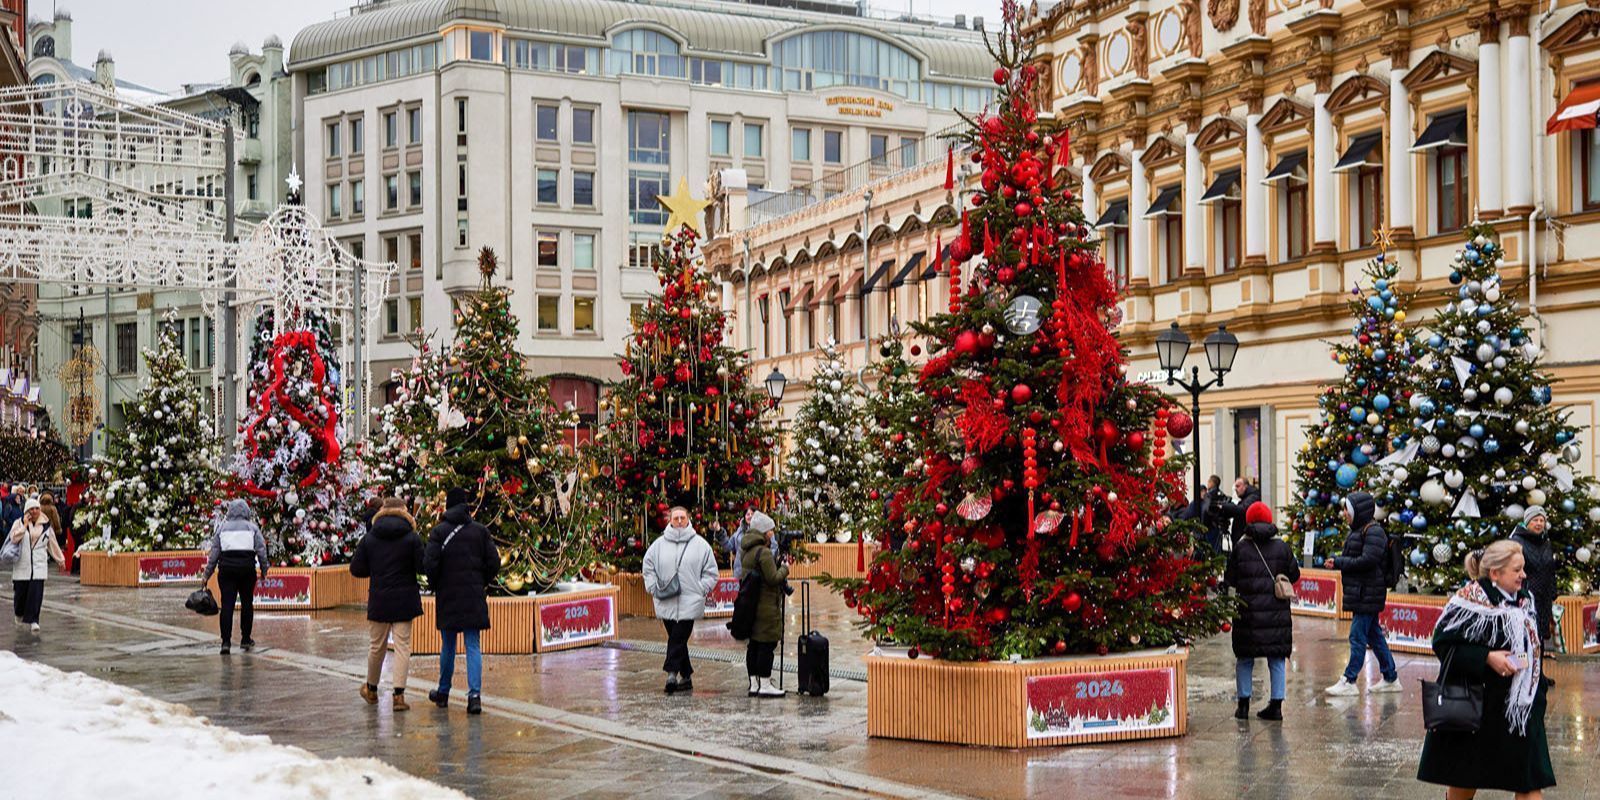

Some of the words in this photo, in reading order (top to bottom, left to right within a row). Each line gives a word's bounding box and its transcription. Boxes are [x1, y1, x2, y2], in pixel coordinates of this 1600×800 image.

[162, 560, 186, 569] 2024
[720, 582, 740, 592] 202
[1301, 580, 1319, 591] 2024
[565, 605, 589, 619] 2024
[1392, 608, 1418, 621] 2024
[1075, 679, 1124, 699] 2024
